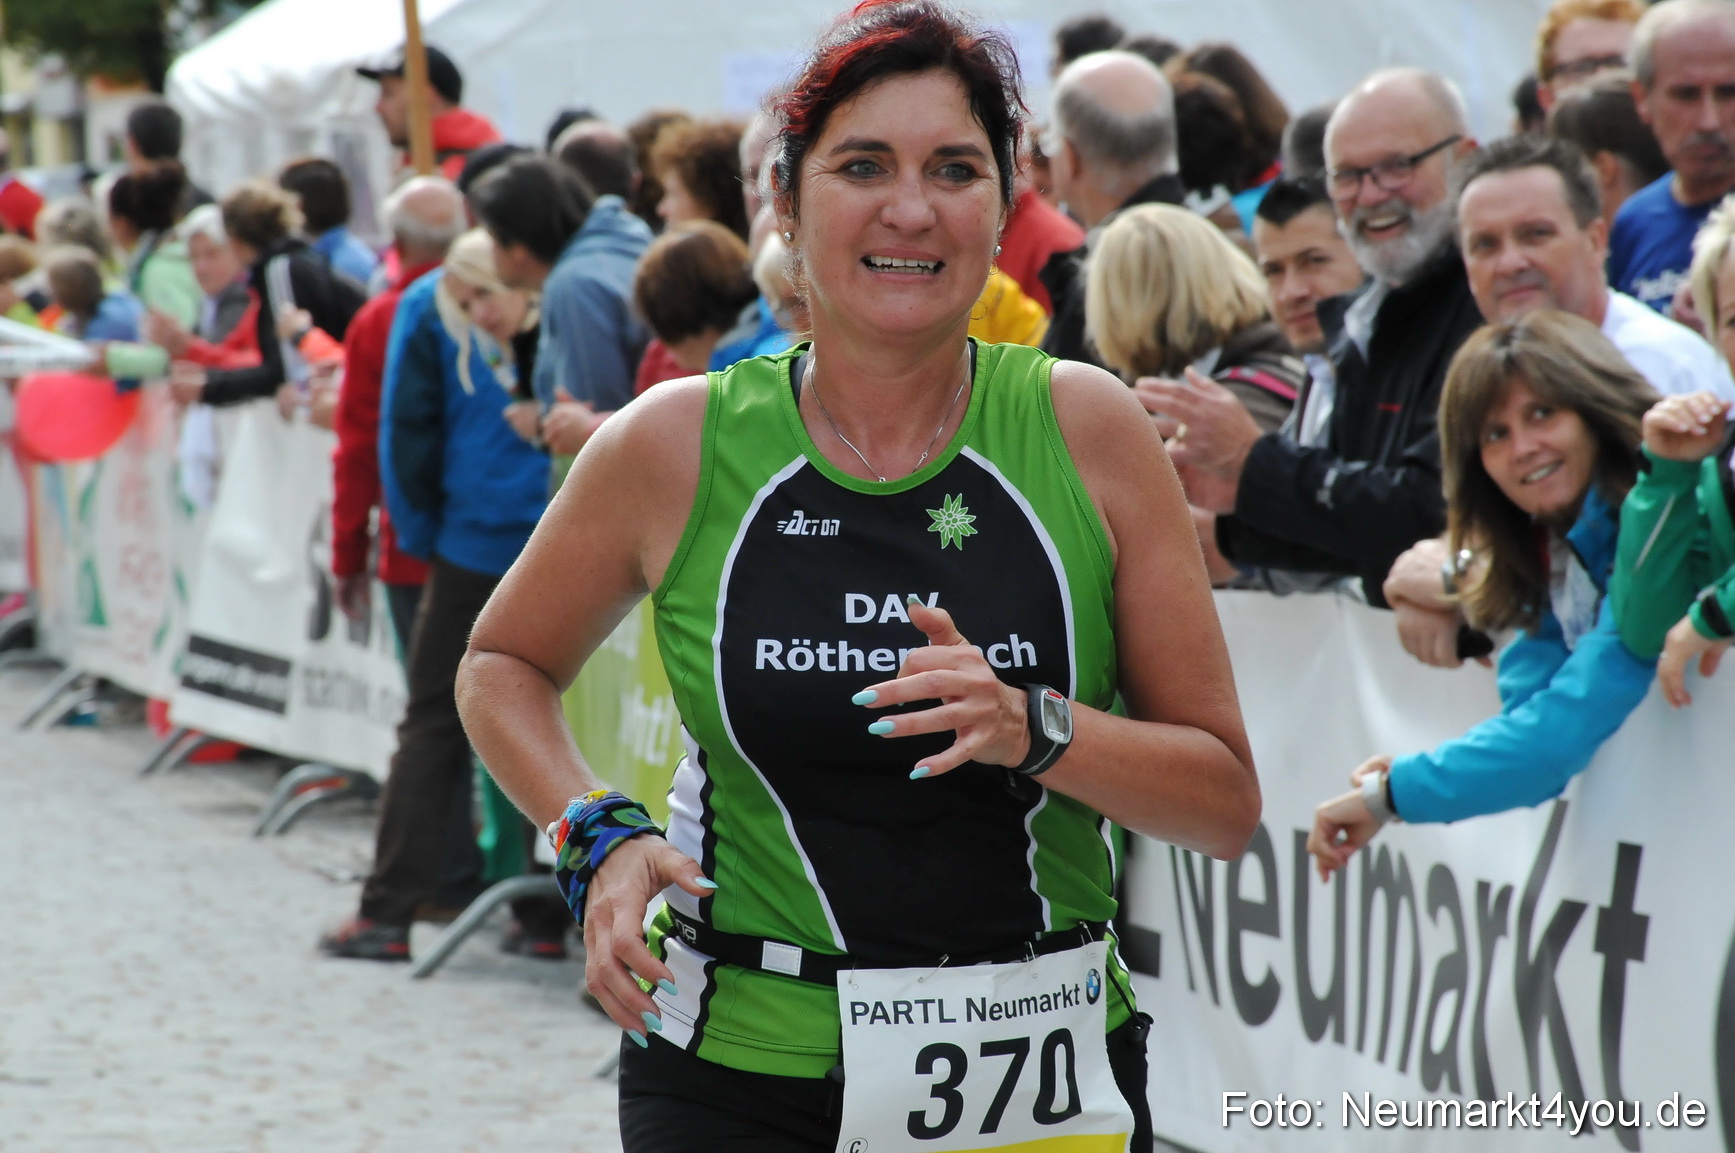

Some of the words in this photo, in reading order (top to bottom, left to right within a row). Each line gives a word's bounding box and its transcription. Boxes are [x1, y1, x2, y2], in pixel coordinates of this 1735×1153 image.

[755, 633, 1038, 672] Röthech
[849, 998, 957, 1026] PARTL
[965, 983, 1081, 1023] Neumarkt
[906, 1027, 1083, 1141] 370
